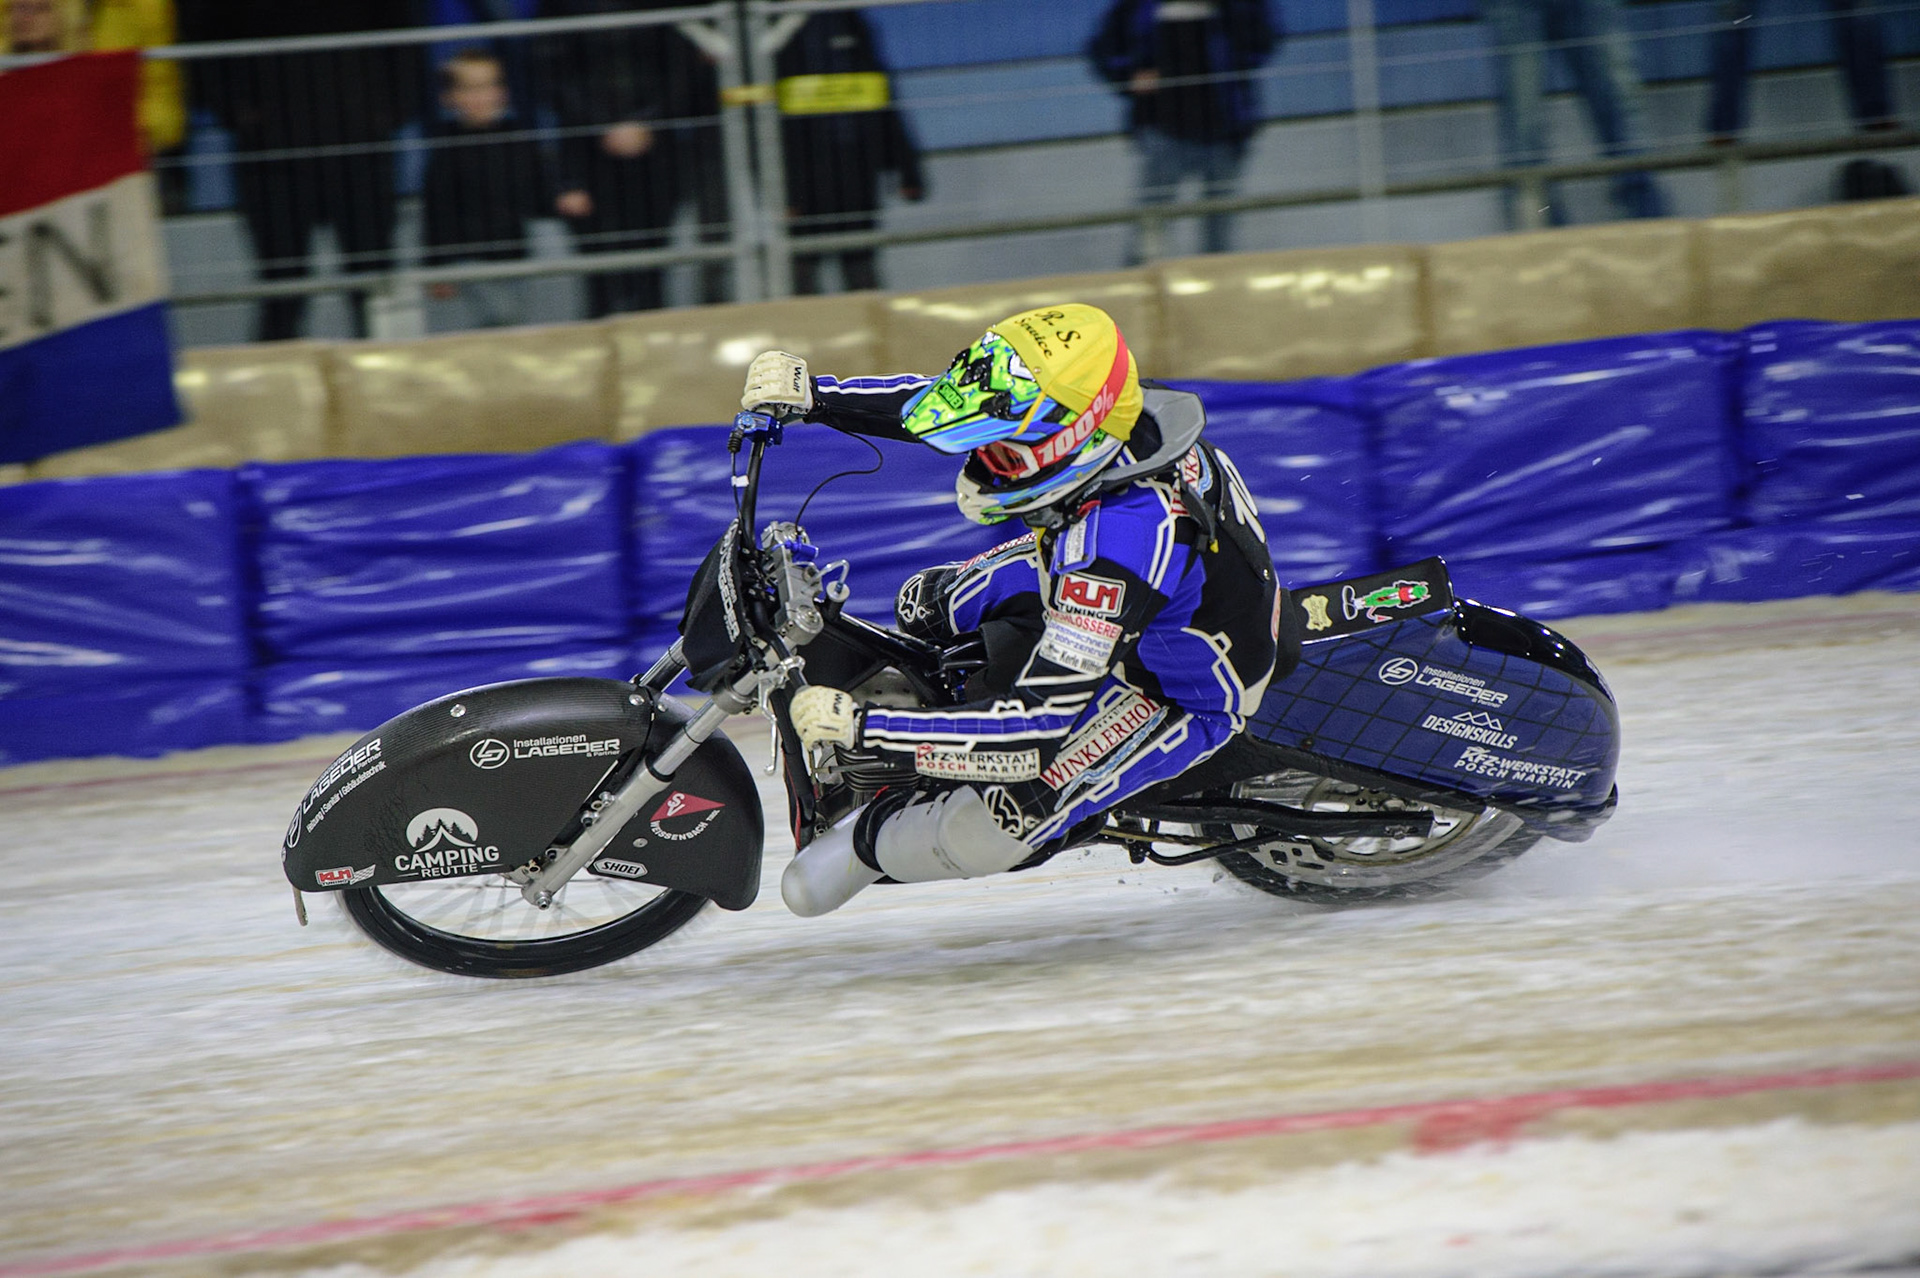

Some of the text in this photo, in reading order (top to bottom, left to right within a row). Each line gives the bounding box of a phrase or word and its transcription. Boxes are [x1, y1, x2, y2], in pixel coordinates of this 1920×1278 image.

[1038, 384, 1114, 465] 100%
[1061, 577, 1119, 610] KLM
[1059, 603, 1104, 620] TUNING
[1422, 665, 1485, 687] Installationen
[1415, 673, 1508, 704] LAGEDER
[513, 734, 586, 748] Installationen
[1422, 715, 1518, 749] DESIGNSKILLS
[514, 739, 620, 759] LAGEDER
[917, 751, 1037, 764] KFZ-WERKSTATT
[357, 751, 382, 770] Partner
[917, 762, 1037, 774] POSCH MARTIN
[1460, 747, 1586, 781] KFZ-WERKSTATT
[303, 738, 381, 814] LAGEDER
[1454, 760, 1575, 789] POSCH MARTIN
[650, 821, 708, 840] WEISSENBACH
[395, 847, 499, 871] CAMPING
[602, 862, 640, 875] SHOEI
[319, 870, 351, 882] KLM
[422, 864, 478, 878] REUTTE
